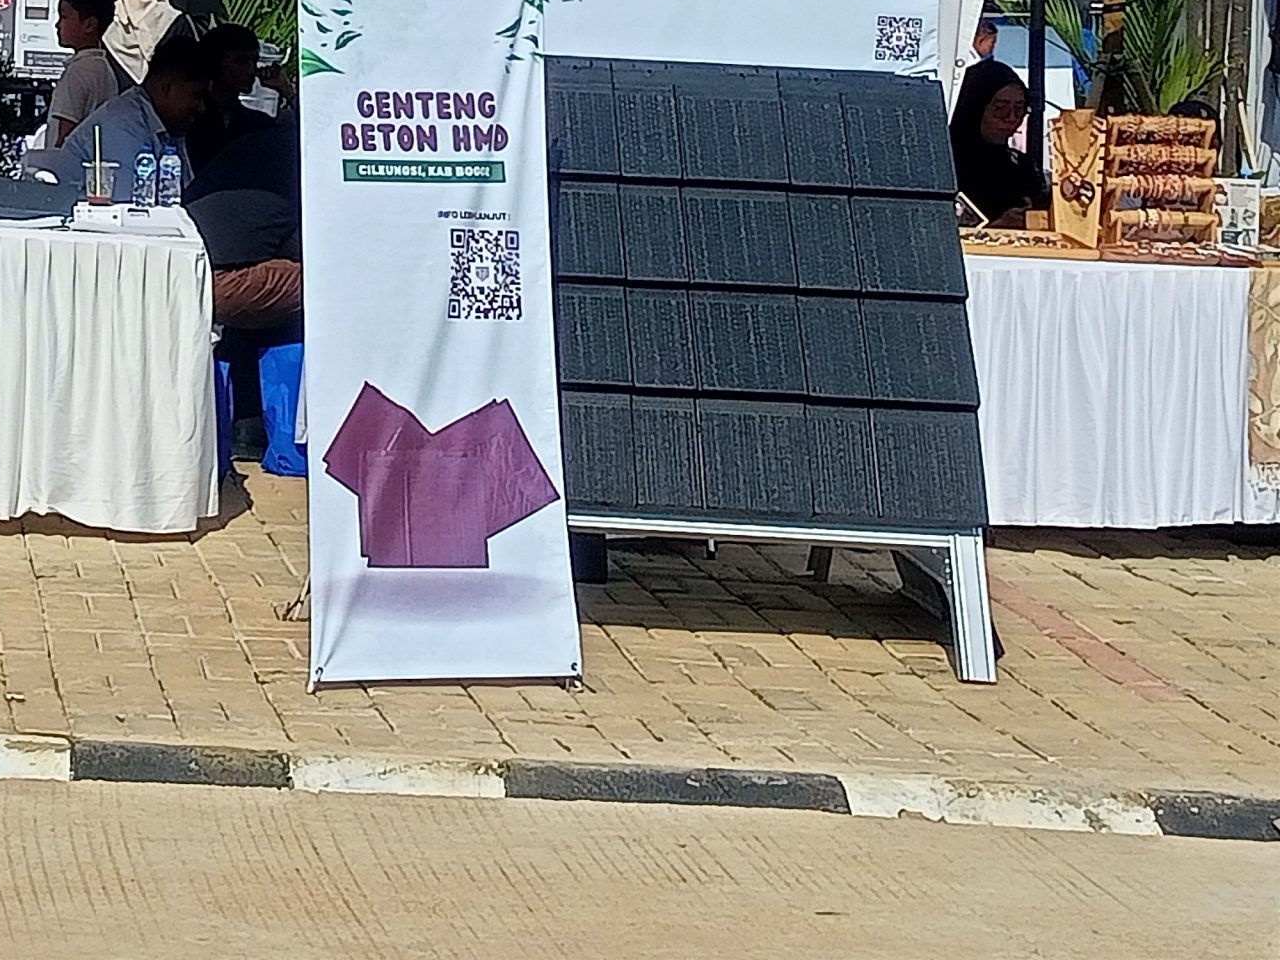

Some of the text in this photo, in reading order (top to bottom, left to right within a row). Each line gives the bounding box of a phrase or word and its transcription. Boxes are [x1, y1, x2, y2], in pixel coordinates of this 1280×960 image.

[356, 90, 497, 121] GENTENG
[340, 123, 509, 153] BETON HMD
